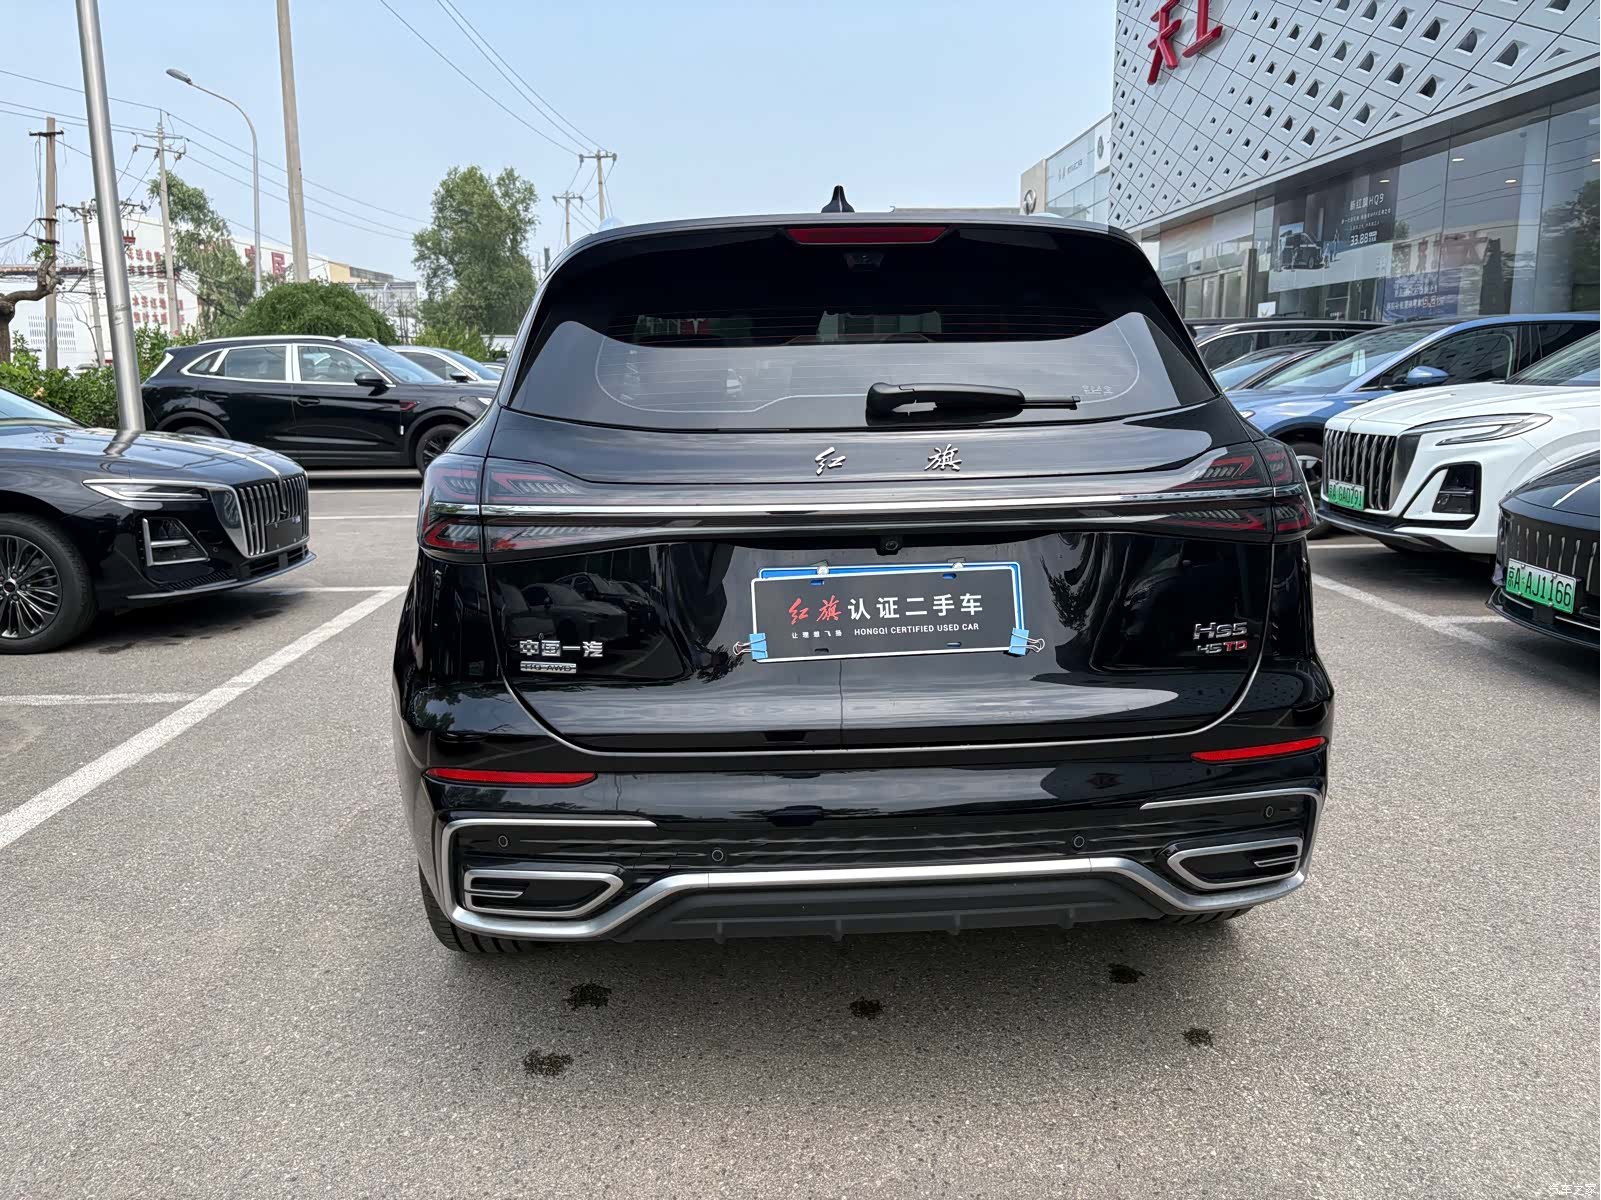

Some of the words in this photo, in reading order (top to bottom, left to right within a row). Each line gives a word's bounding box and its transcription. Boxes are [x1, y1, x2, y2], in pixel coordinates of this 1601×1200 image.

[815, 444, 962, 476] 红旗
[854, 627, 888, 636] HONGQI
[890, 624, 935, 634] CERTIFIED
[936, 623, 960, 632] USED
[961, 622, 980, 631] CAR
[519, 639, 604, 658] 中国一汽
